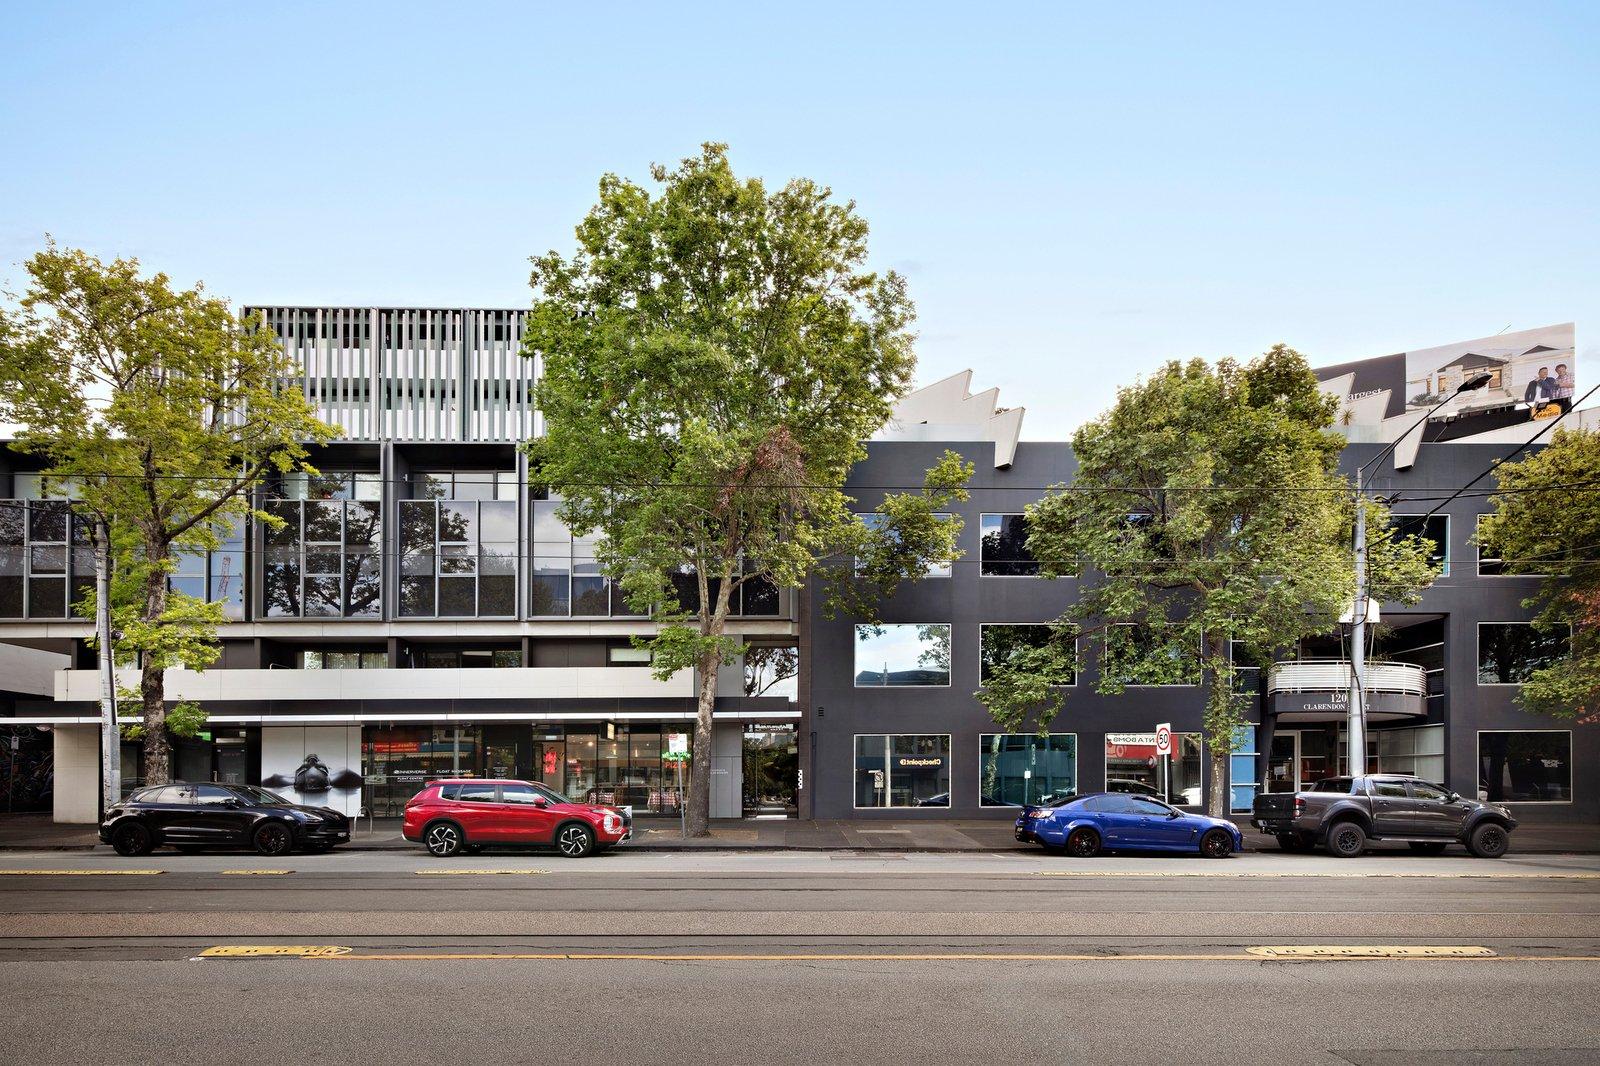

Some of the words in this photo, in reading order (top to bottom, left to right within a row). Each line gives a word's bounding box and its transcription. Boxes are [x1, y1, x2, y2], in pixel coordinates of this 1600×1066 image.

[1330, 693, 1347, 703] 120
[1303, 703, 1346, 711] CLARENDON
[1159, 734, 1168, 745] 50
[664, 761, 688, 769] PIZA
